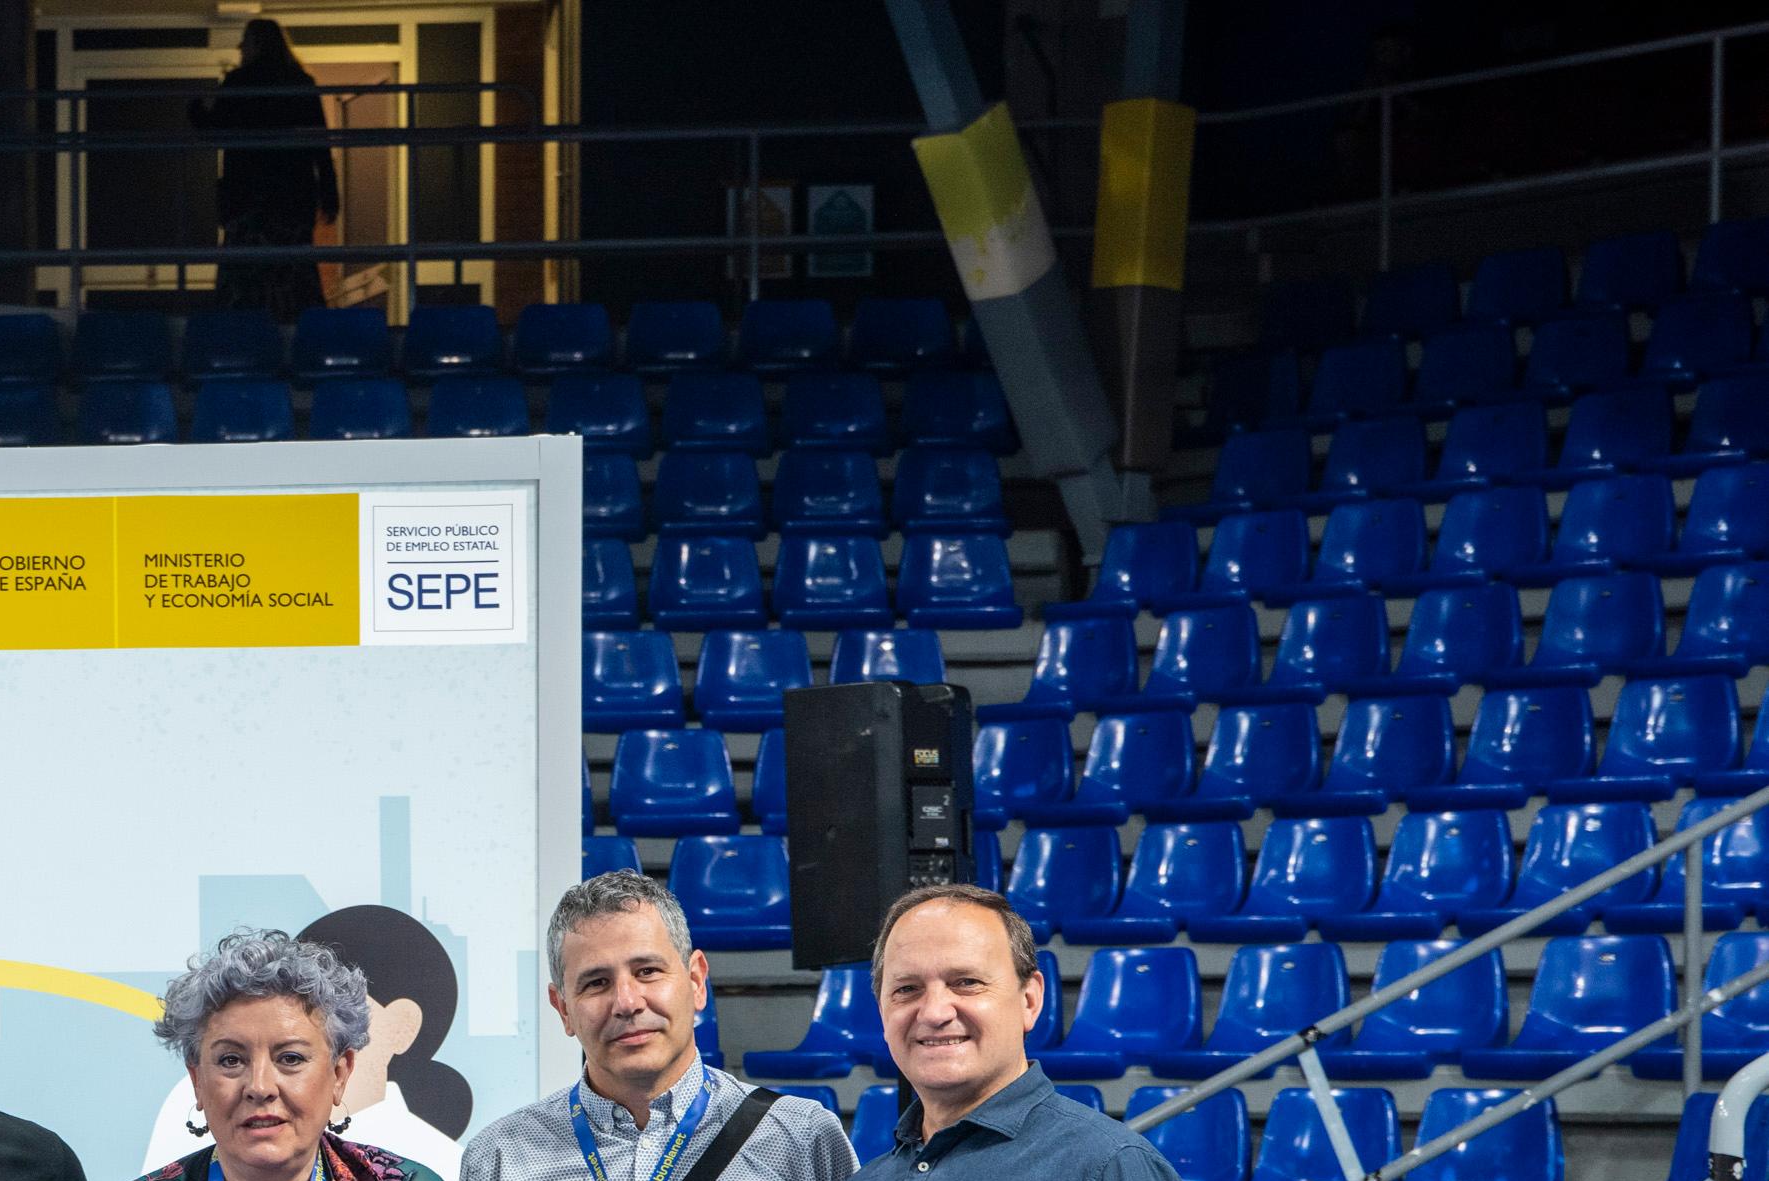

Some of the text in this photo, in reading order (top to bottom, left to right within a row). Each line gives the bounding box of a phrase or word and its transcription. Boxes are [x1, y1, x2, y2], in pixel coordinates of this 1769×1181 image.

[386, 523, 500, 537] SERVICIO PÚBLICO
[386, 540, 500, 552] DE EMPLEO ESTATAL
[144, 553, 245, 568] MINISTERIO
[15, 572, 87, 591] ESPAÑA
[144, 573, 251, 592] DE TRABAJO
[144, 590, 334, 608] Y ECONOMÍA SOCIAL
[387, 573, 500, 611] SEPE
